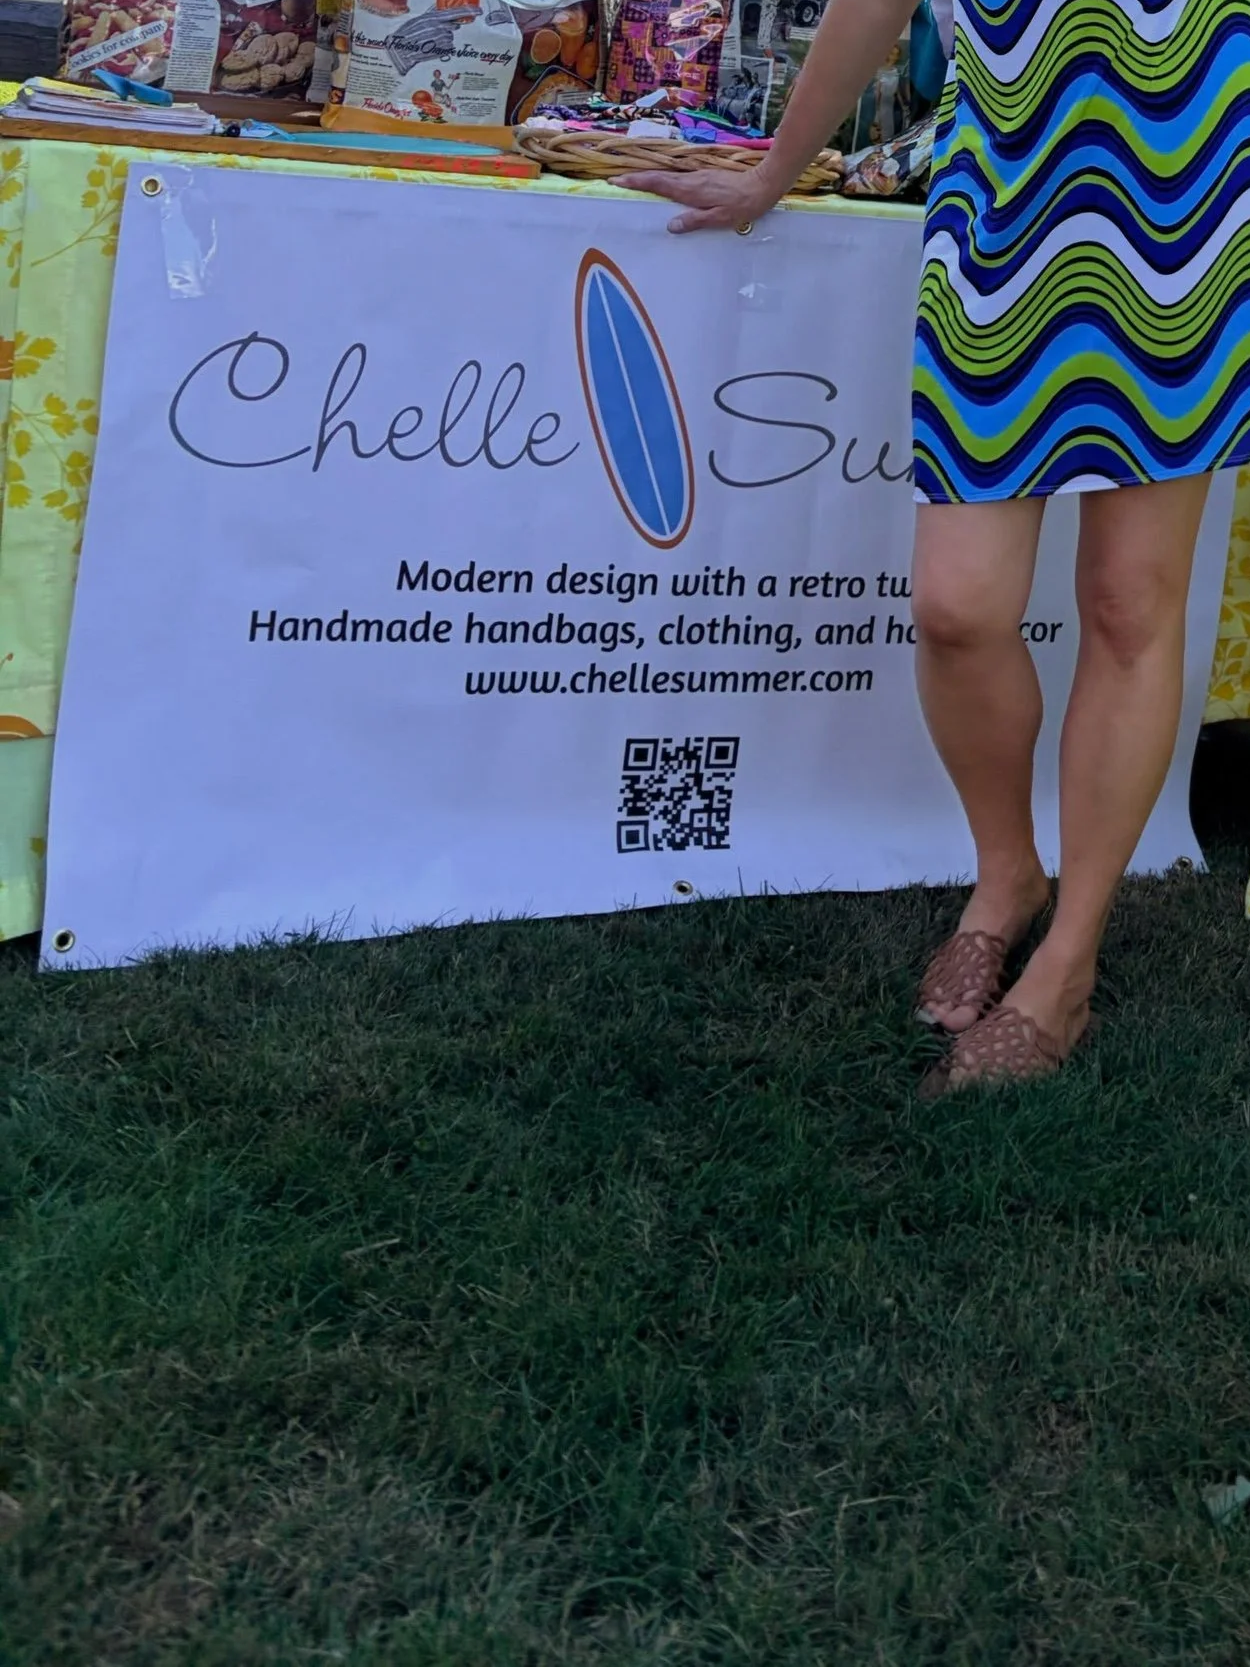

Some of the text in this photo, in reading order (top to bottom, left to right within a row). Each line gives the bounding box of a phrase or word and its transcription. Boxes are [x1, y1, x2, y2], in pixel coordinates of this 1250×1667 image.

[101, 38, 121, 57] for
[456, 43, 479, 59] Juice
[168, 330, 913, 488] Chelle Su
[396, 559, 534, 594] Modern
[546, 562, 658, 603] design
[671, 566, 746, 598] with
[757, 572, 777, 597] a
[788, 571, 866, 599] retro
[248, 609, 453, 643] Handmade
[464, 611, 646, 652] handbags,
[658, 615, 802, 653] clothing,
[814, 616, 876, 646] and
[464, 662, 874, 696] www.chellesummer.com
